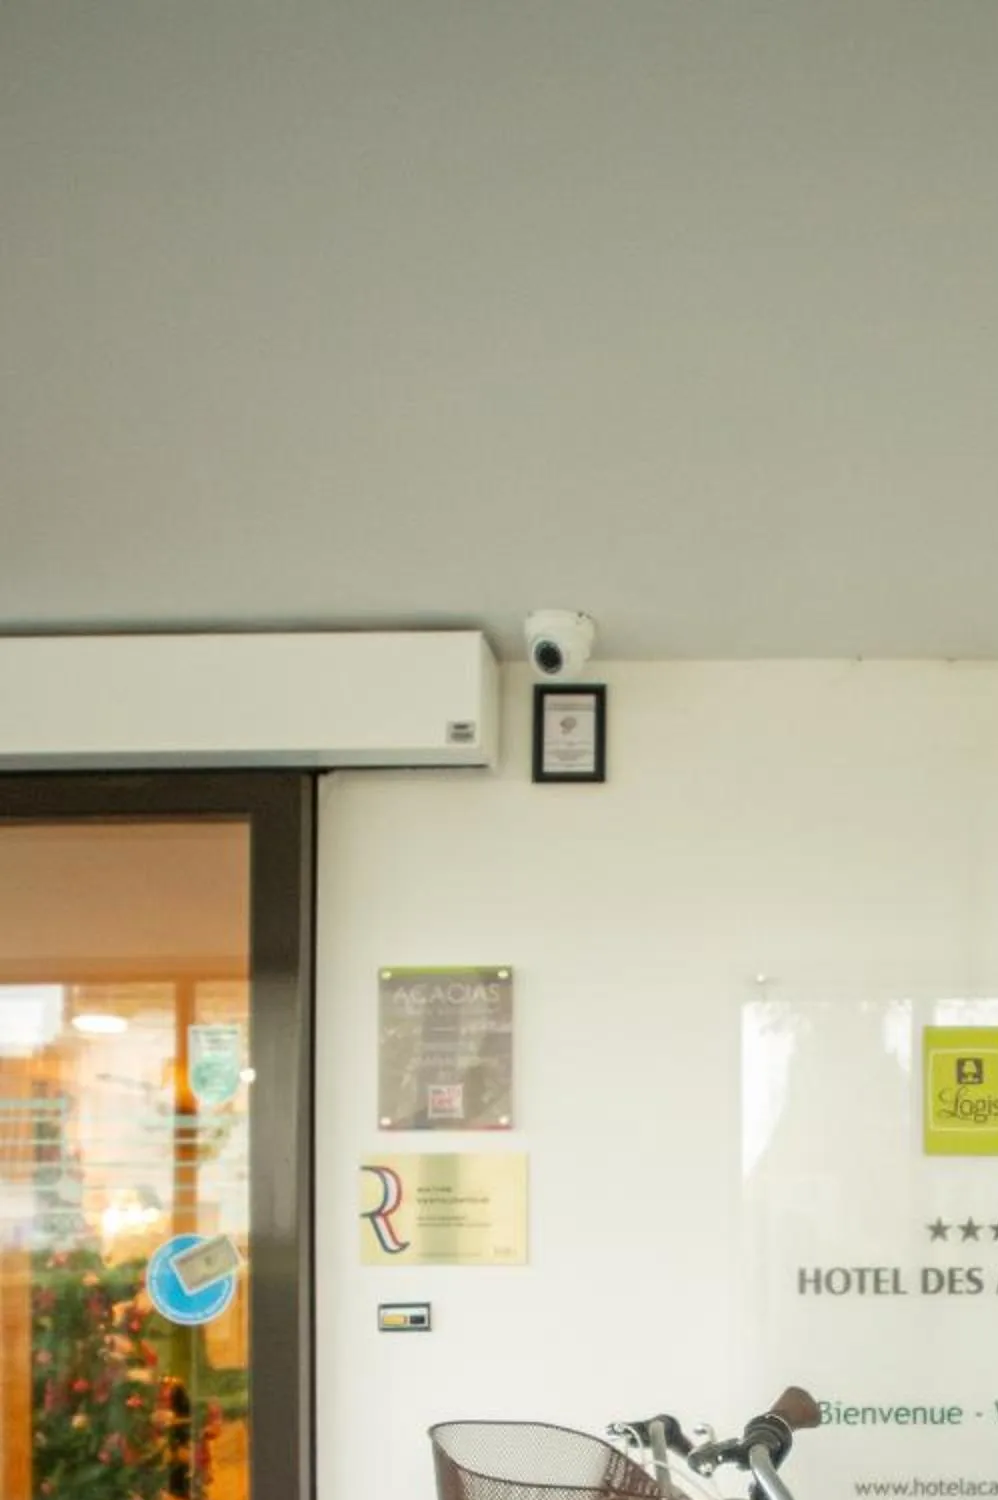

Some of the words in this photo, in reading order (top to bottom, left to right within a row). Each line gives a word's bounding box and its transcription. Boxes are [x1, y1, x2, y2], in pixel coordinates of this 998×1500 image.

[393, 983, 500, 1005] ACACIAS
[798, 1267, 907, 1295] HOTEL
[921, 1267, 984, 1295] DES
[820, 1400, 963, 1425] Bienvenue
